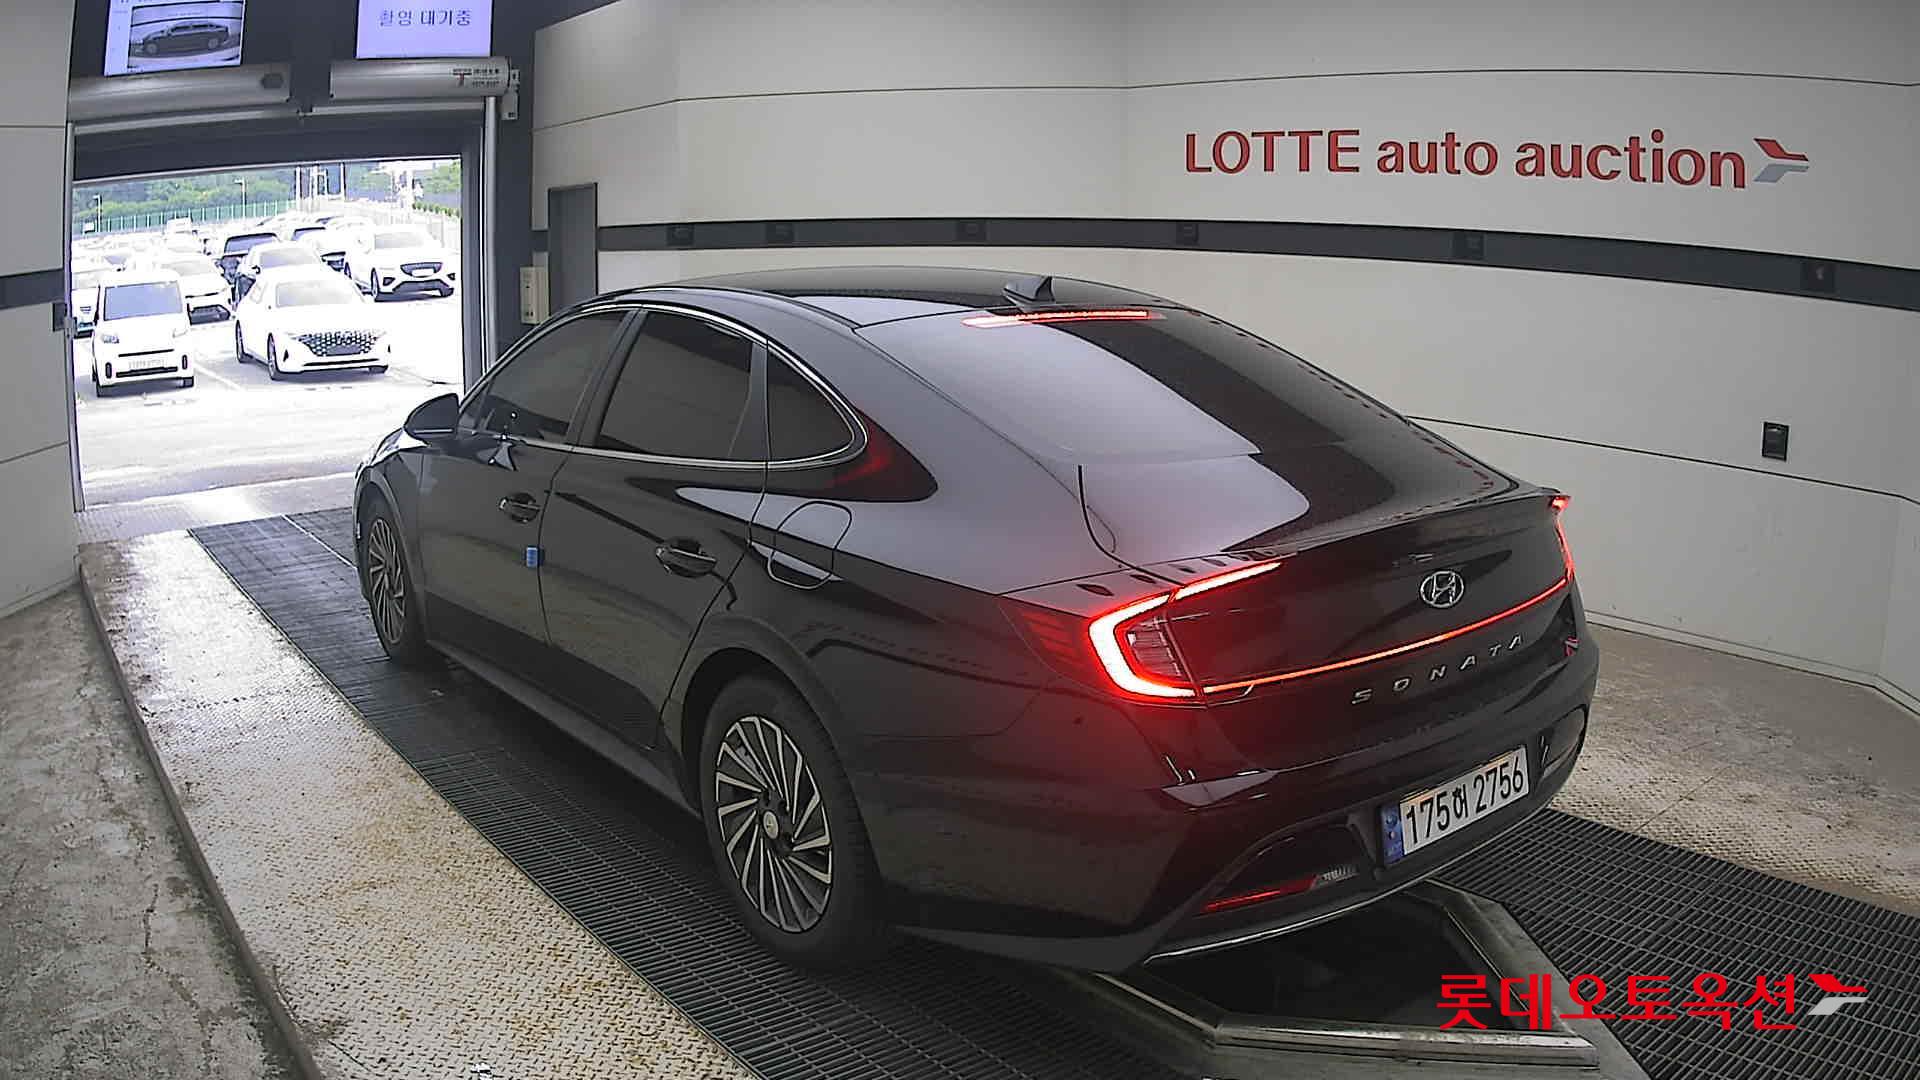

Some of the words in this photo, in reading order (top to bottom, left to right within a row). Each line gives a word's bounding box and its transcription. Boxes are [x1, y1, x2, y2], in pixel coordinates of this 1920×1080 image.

[420, 9, 471, 26] 대기중
[1185, 129, 1360, 174] LOTTE
[1376, 131, 1498, 176] auto
[1514, 128, 1746, 189] auction
[1351, 633, 1523, 705] SONATA
